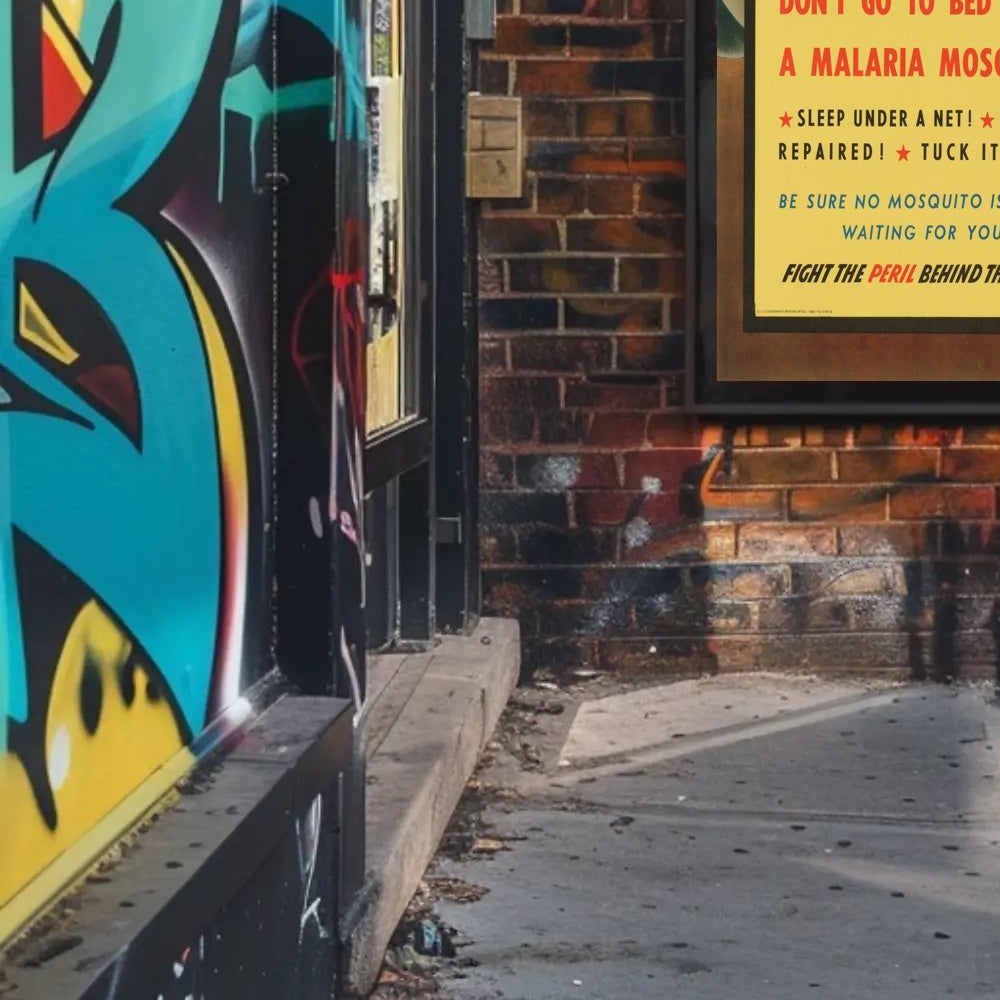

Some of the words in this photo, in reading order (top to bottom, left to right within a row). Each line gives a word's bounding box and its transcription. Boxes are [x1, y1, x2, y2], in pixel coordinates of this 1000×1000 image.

[779, 47, 796, 77] A
[811, 47, 925, 77] MALARIA
[797, 109, 845, 127] SLEEP
[853, 109, 908, 127] UNDER
[915, 109, 926, 127] A
[933, 109, 972, 127] NET!
[921, 143, 970, 161] TUCK
[982, 143, 998, 160] IT
[779, 194, 797, 209] BE
[806, 194, 847, 209] SURE
[854, 194, 880, 209] NO
[887, 194, 983, 210] MOSQUITO
[842, 225, 916, 240] WAITING
[925, 225, 957, 240] FOR
[782, 263, 835, 283] FIGHT
[833, 263, 867, 283] THE
[867, 263, 917, 283] PERIL
[918, 263, 983, 283] BEHIND
